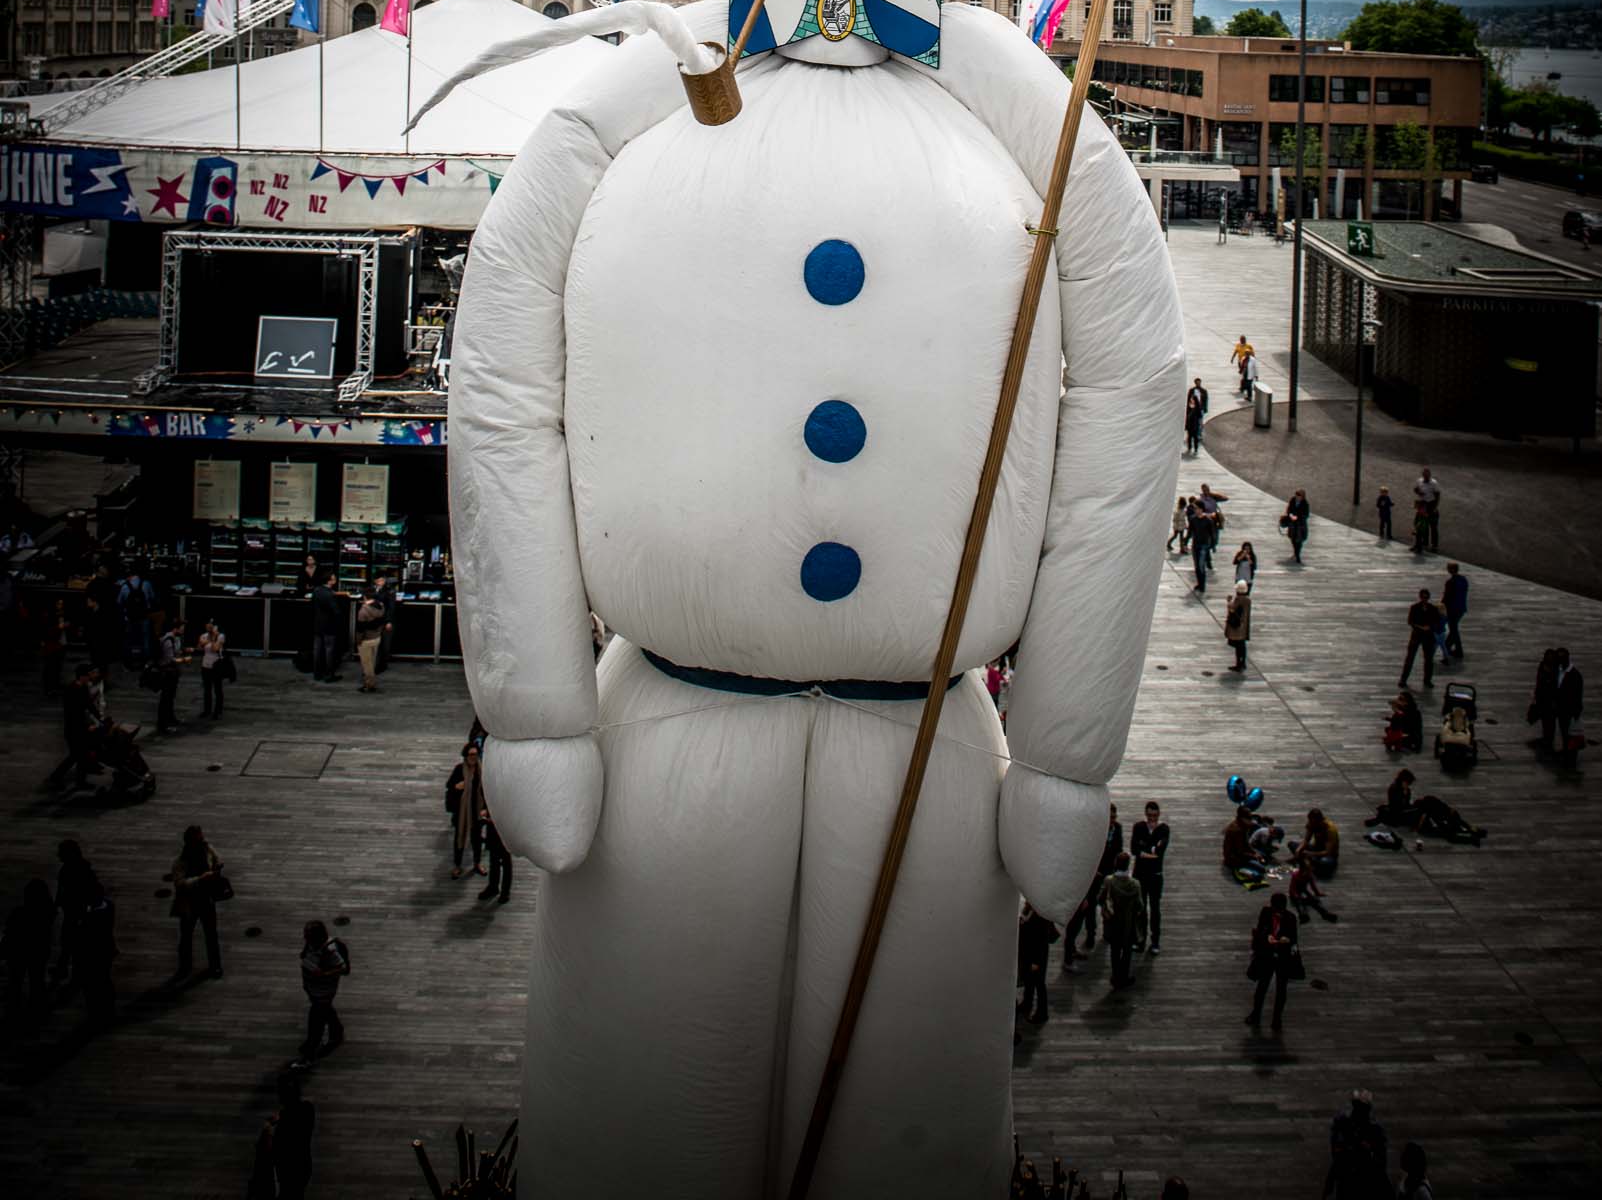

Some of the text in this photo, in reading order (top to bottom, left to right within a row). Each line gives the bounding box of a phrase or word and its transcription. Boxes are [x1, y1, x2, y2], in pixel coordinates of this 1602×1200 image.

[249, 179, 266, 195] NZ
[272, 173, 290, 190] NZ
[263, 195, 290, 222] NZ
[308, 194, 328, 213] NZ
[165, 411, 208, 437] BAR
